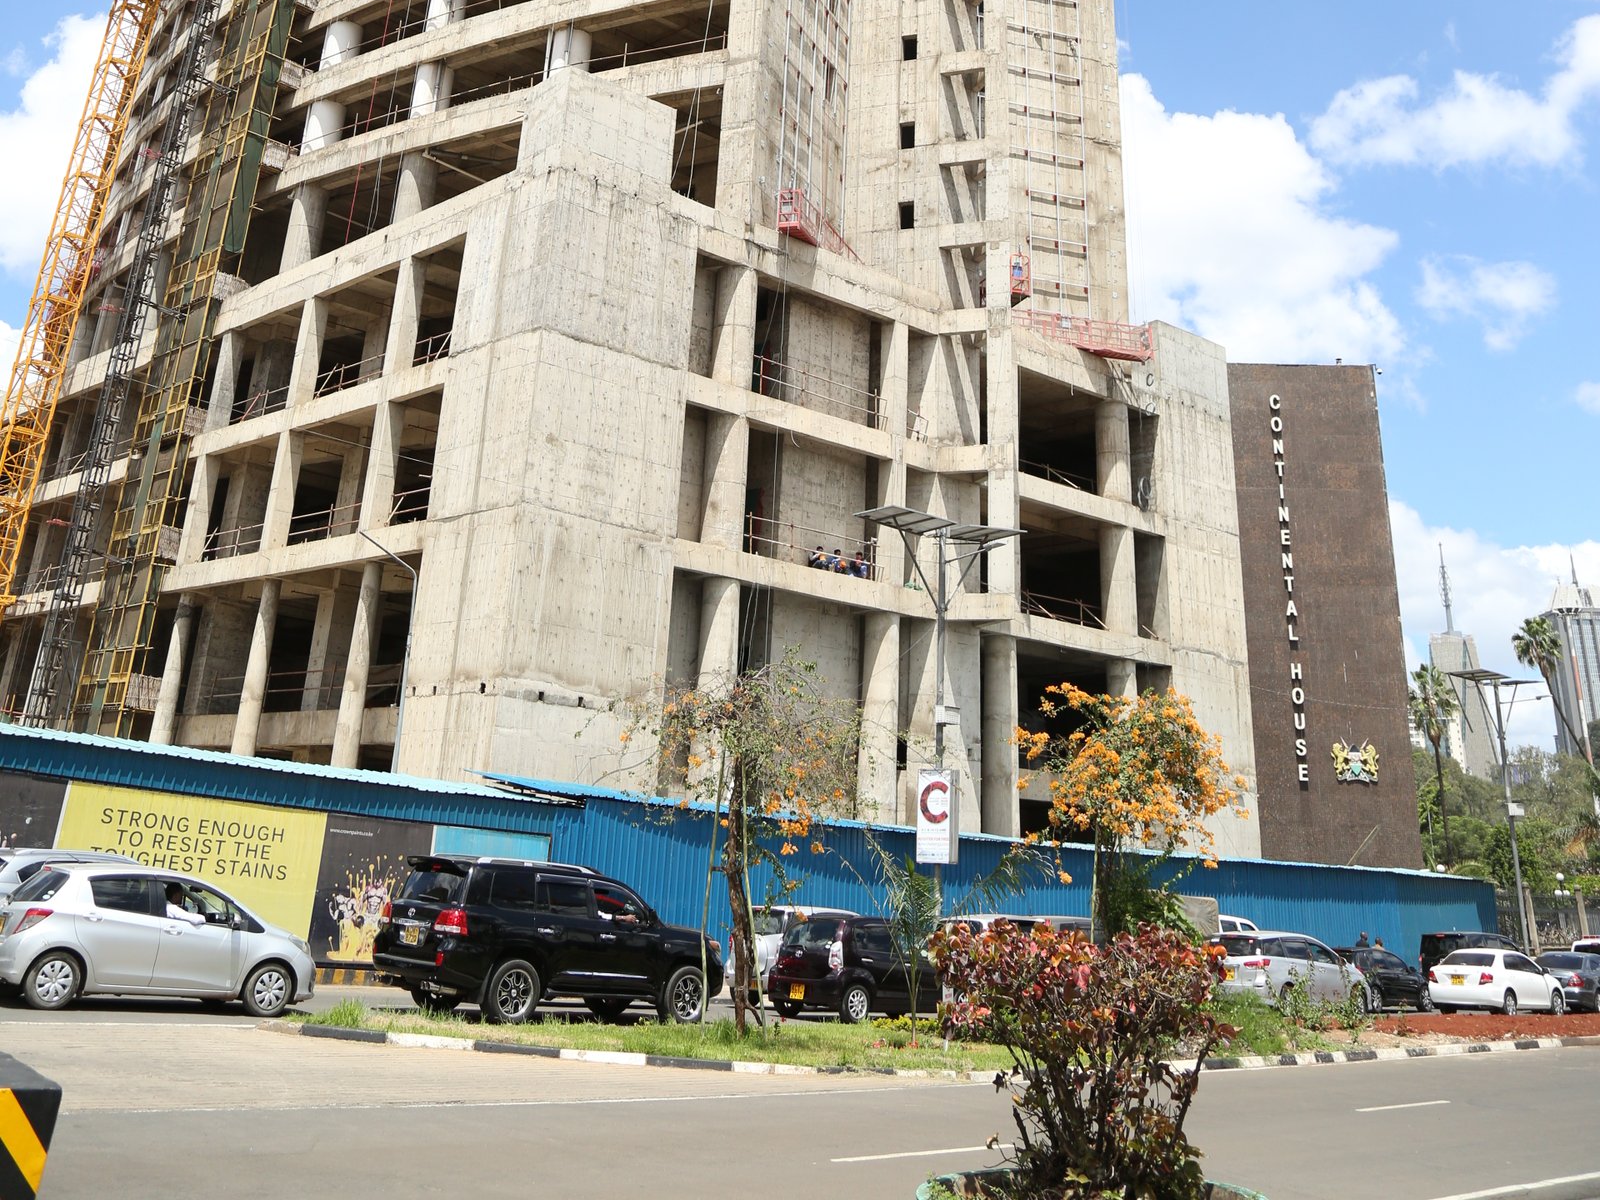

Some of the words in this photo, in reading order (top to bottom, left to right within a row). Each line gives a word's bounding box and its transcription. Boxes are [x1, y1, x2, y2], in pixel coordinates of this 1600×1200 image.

[1269, 394, 1299, 643] CONTINENTAL
[1290, 662, 1309, 783] HOUSE
[101, 807, 190, 833] STRONG
[198, 819, 285, 843] ENOUGH
[116, 829, 144, 847] TO
[152, 833, 226, 856] RESIST
[233, 841, 272, 860] THE
[90, 846, 208, 873] GHEST
[214, 859, 288, 881] STAINS
